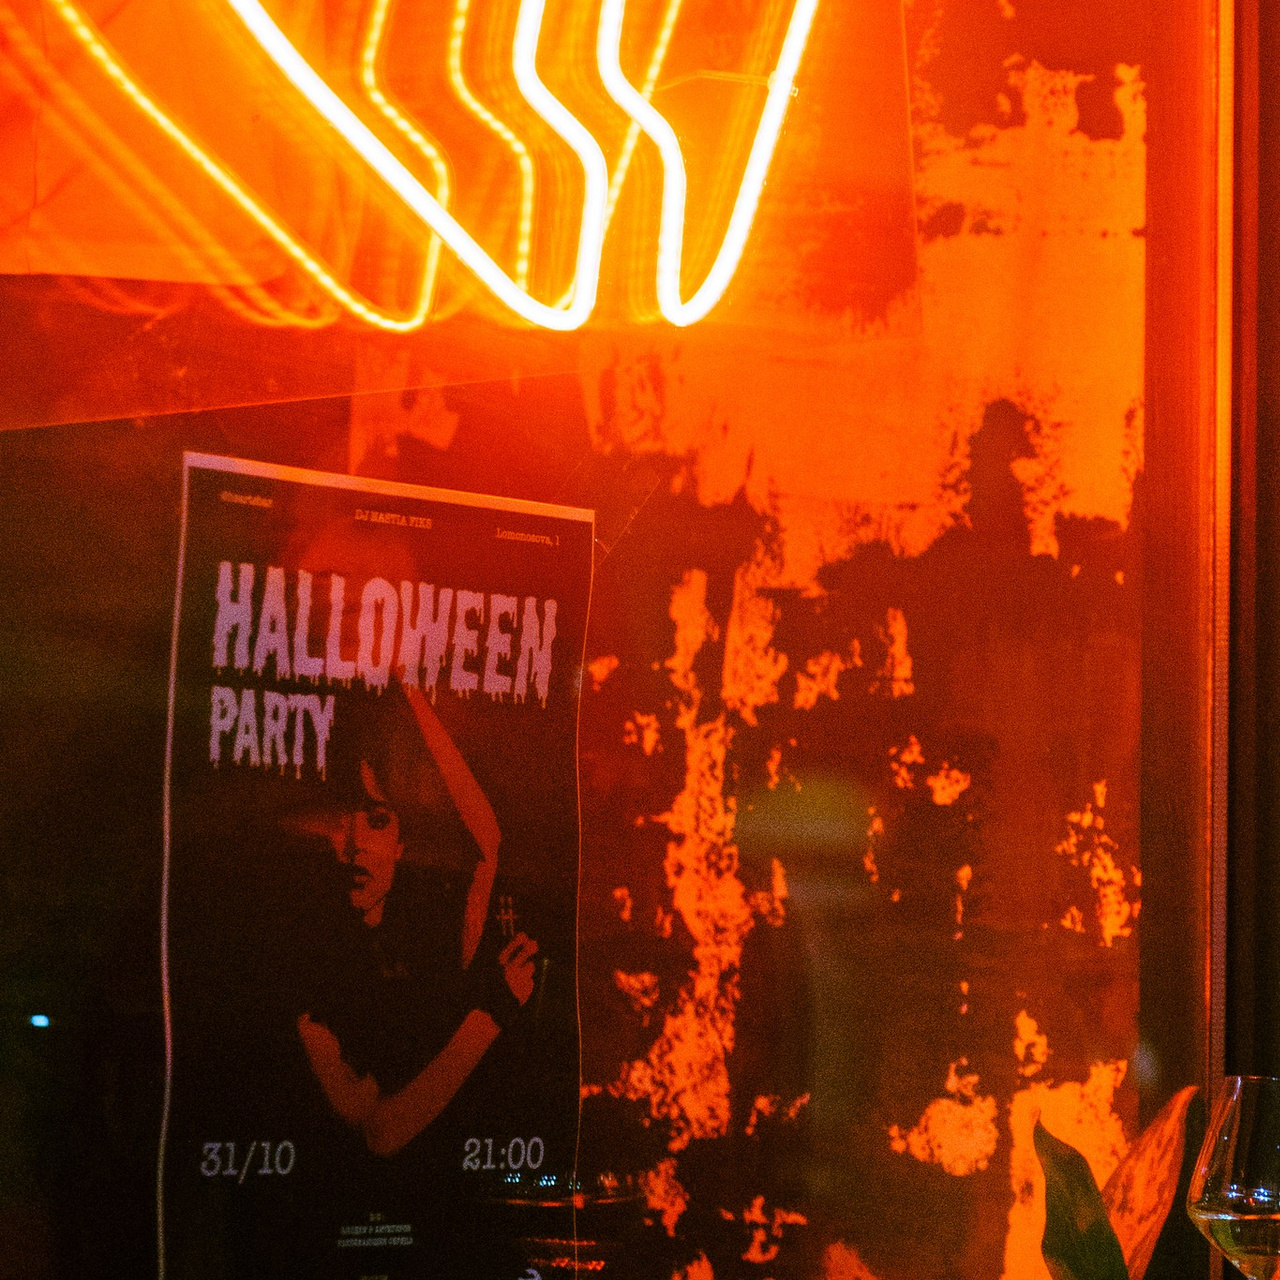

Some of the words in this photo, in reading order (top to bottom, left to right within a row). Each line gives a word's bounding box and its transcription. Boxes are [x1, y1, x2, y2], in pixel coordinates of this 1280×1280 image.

[354, 508, 369, 522] DJ
[212, 560, 558, 709] HALLOWEEN
[209, 686, 335, 781] PARTY
[201, 1141, 296, 1184] 31/10
[463, 1136, 545, 1172] 21:00
